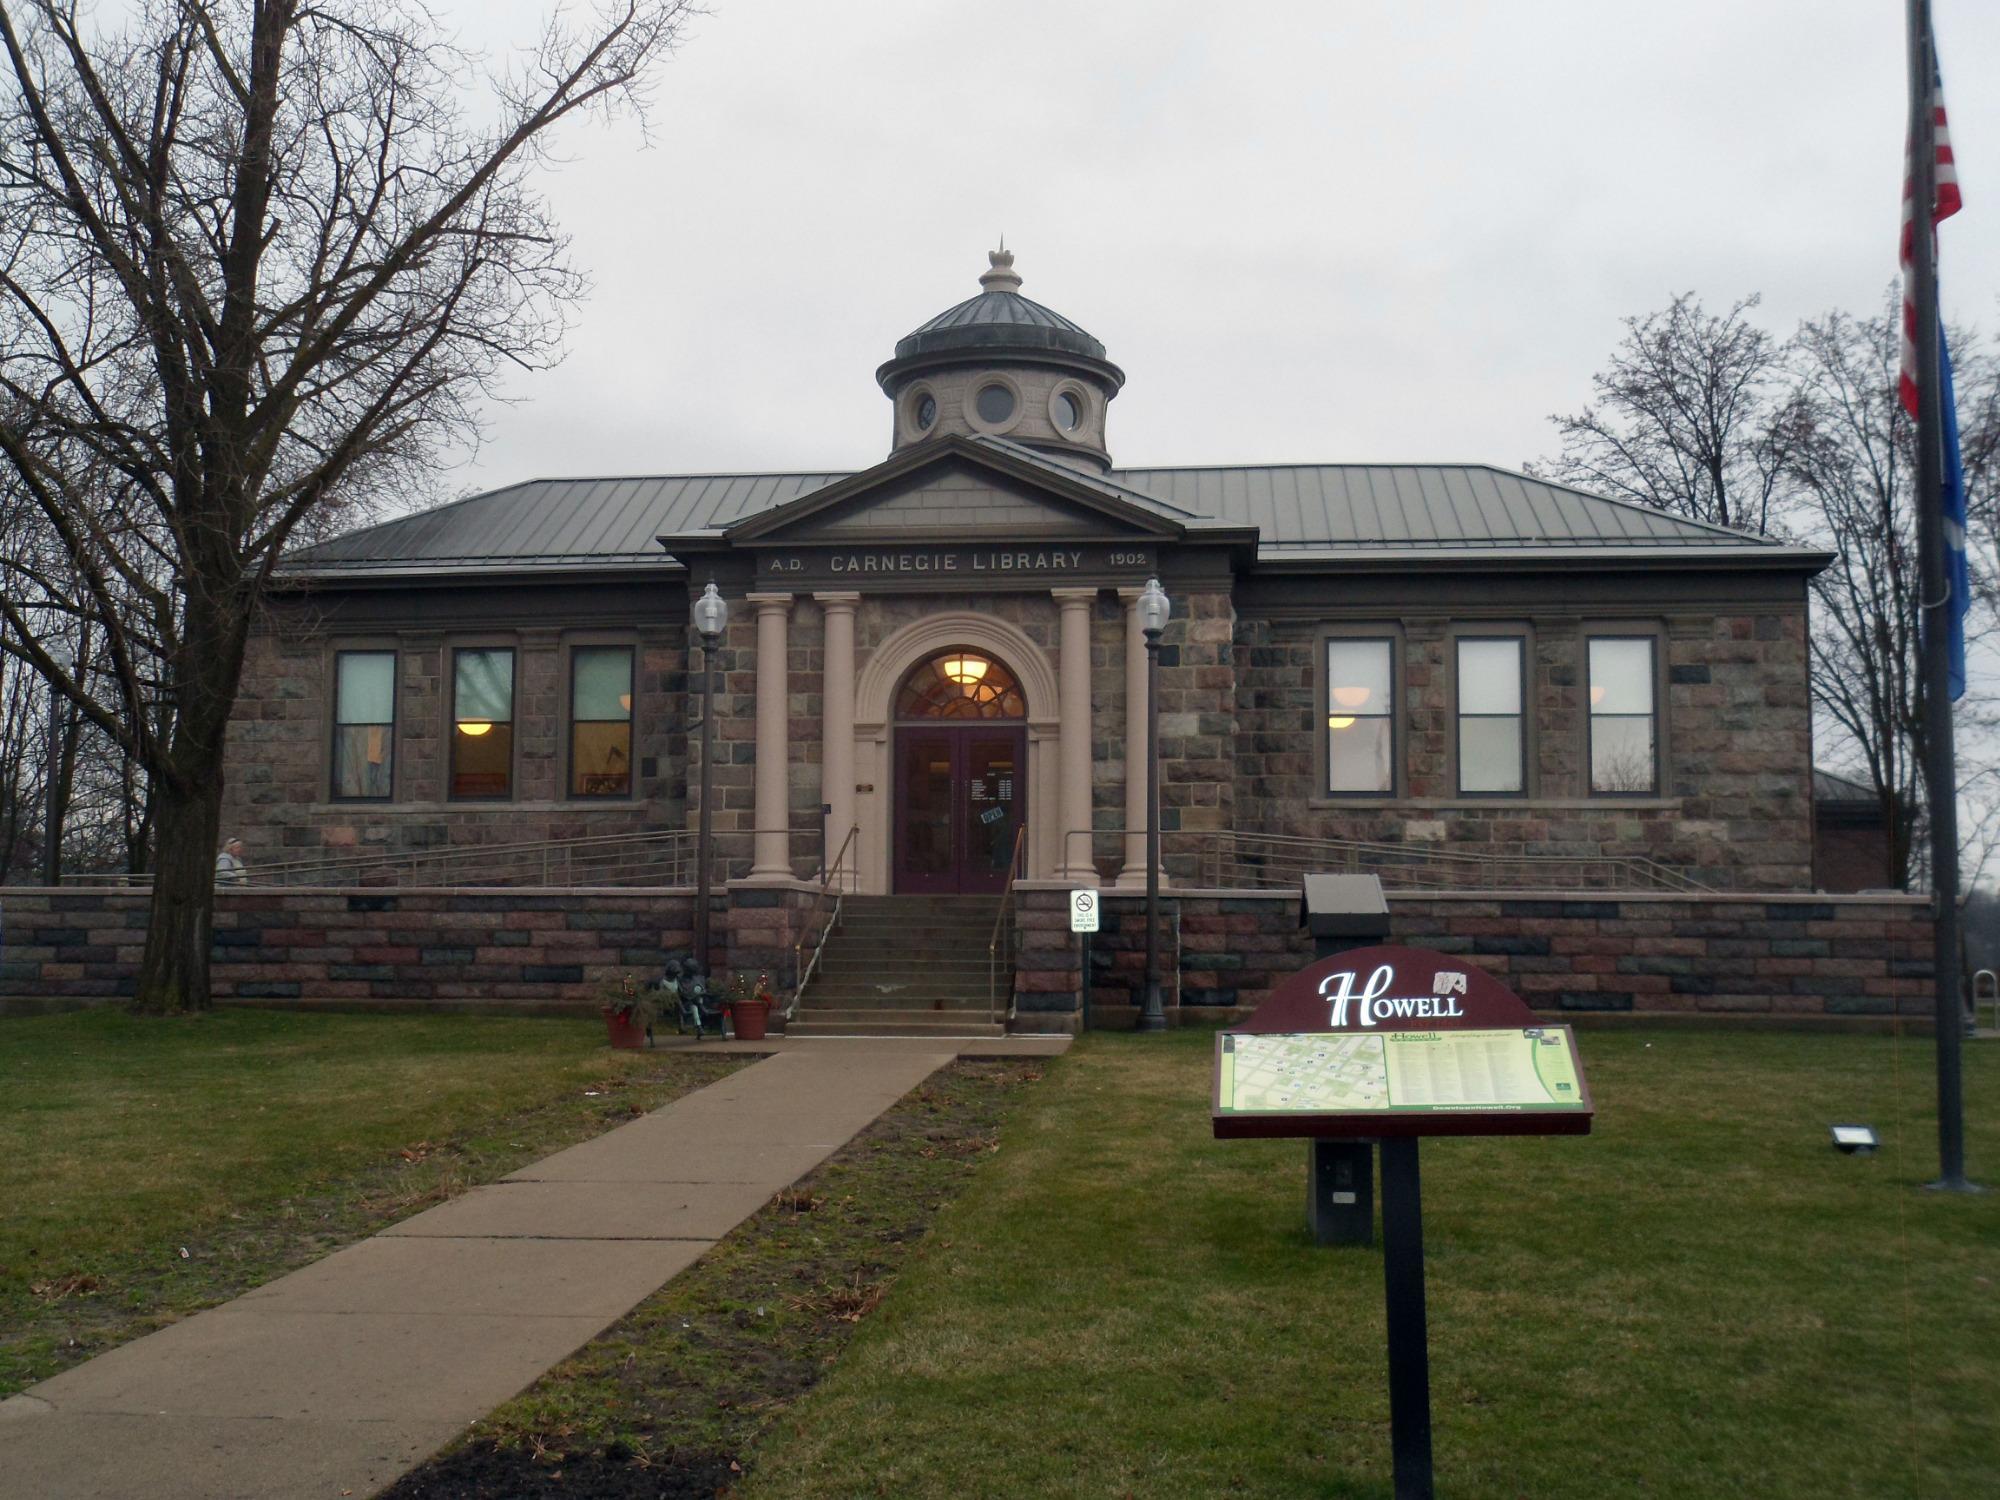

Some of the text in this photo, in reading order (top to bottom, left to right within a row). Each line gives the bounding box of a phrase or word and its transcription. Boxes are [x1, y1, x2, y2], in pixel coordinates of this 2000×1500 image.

[770, 552, 1146, 572] A.D. CARNEGIE LIBRARY 1902
